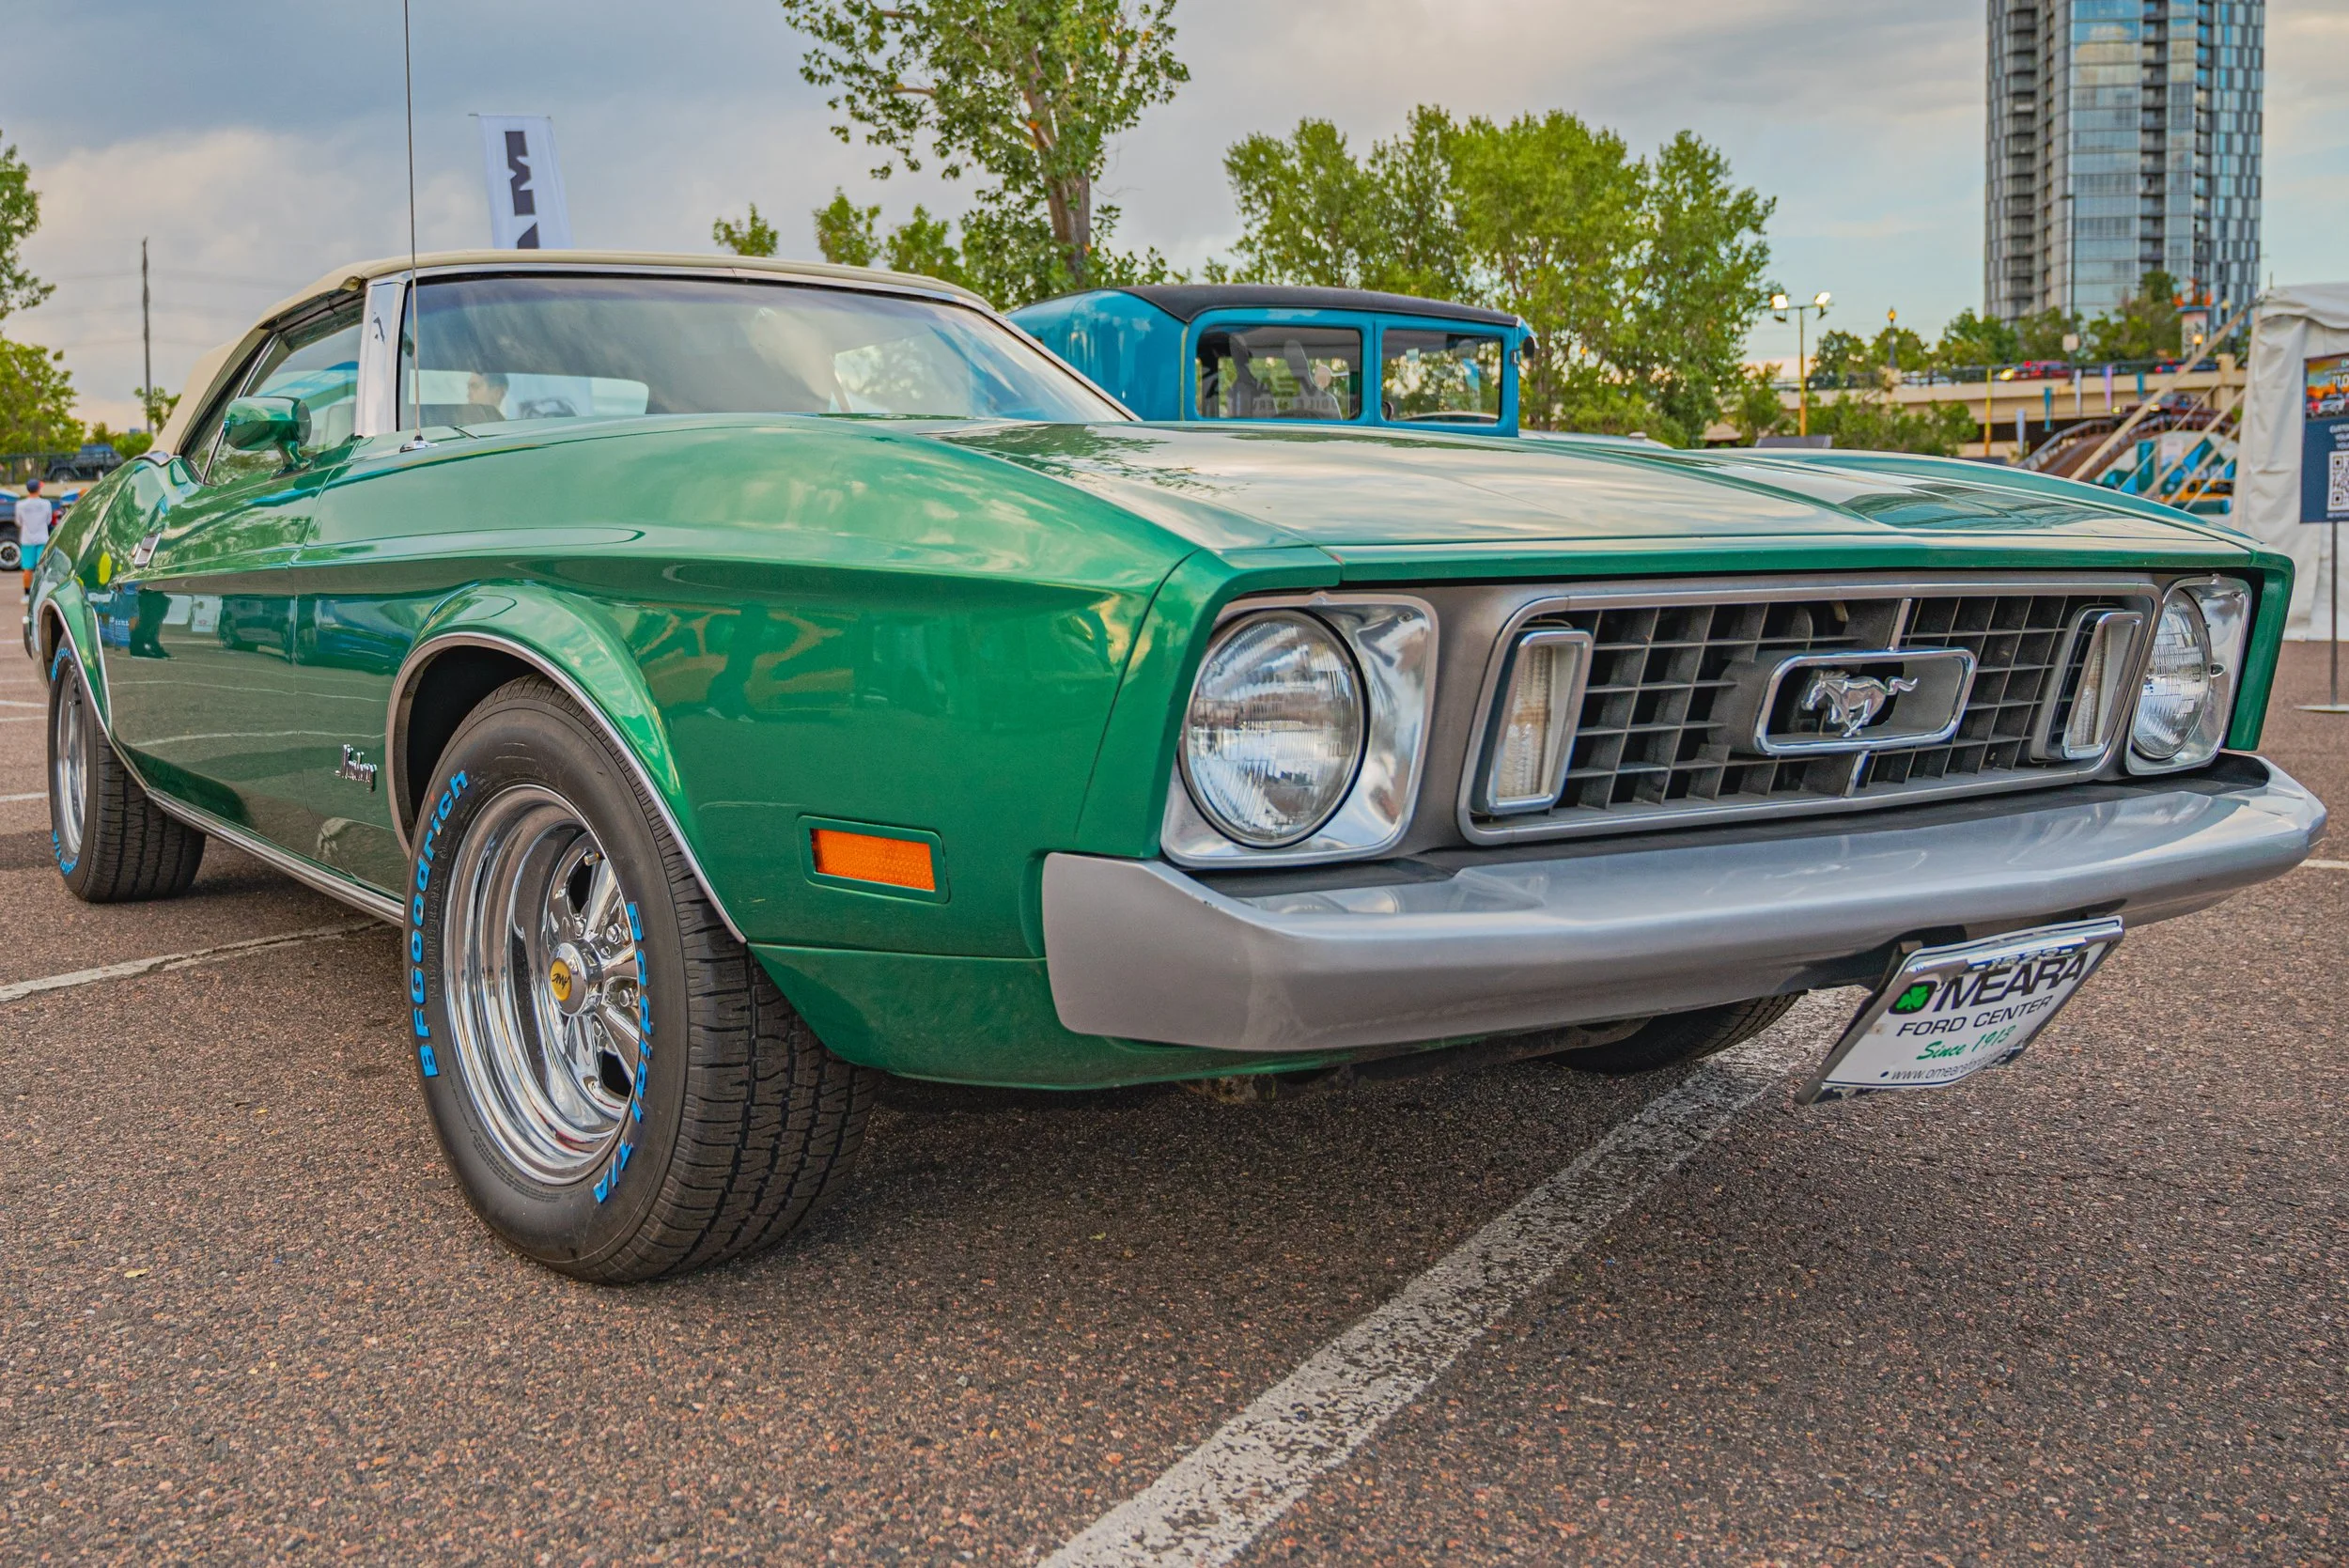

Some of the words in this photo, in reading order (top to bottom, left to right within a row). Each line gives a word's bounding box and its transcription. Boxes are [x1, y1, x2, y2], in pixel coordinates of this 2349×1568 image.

[411, 769, 469, 1078] BFGoodrich
[625, 900, 654, 1125] Radial
[1896, 1016, 1967, 1036] FORD
[1973, 995, 2053, 1028] CENTER
[1916, 1040, 1968, 1061] Since
[593, 1137, 633, 1203] T/A
